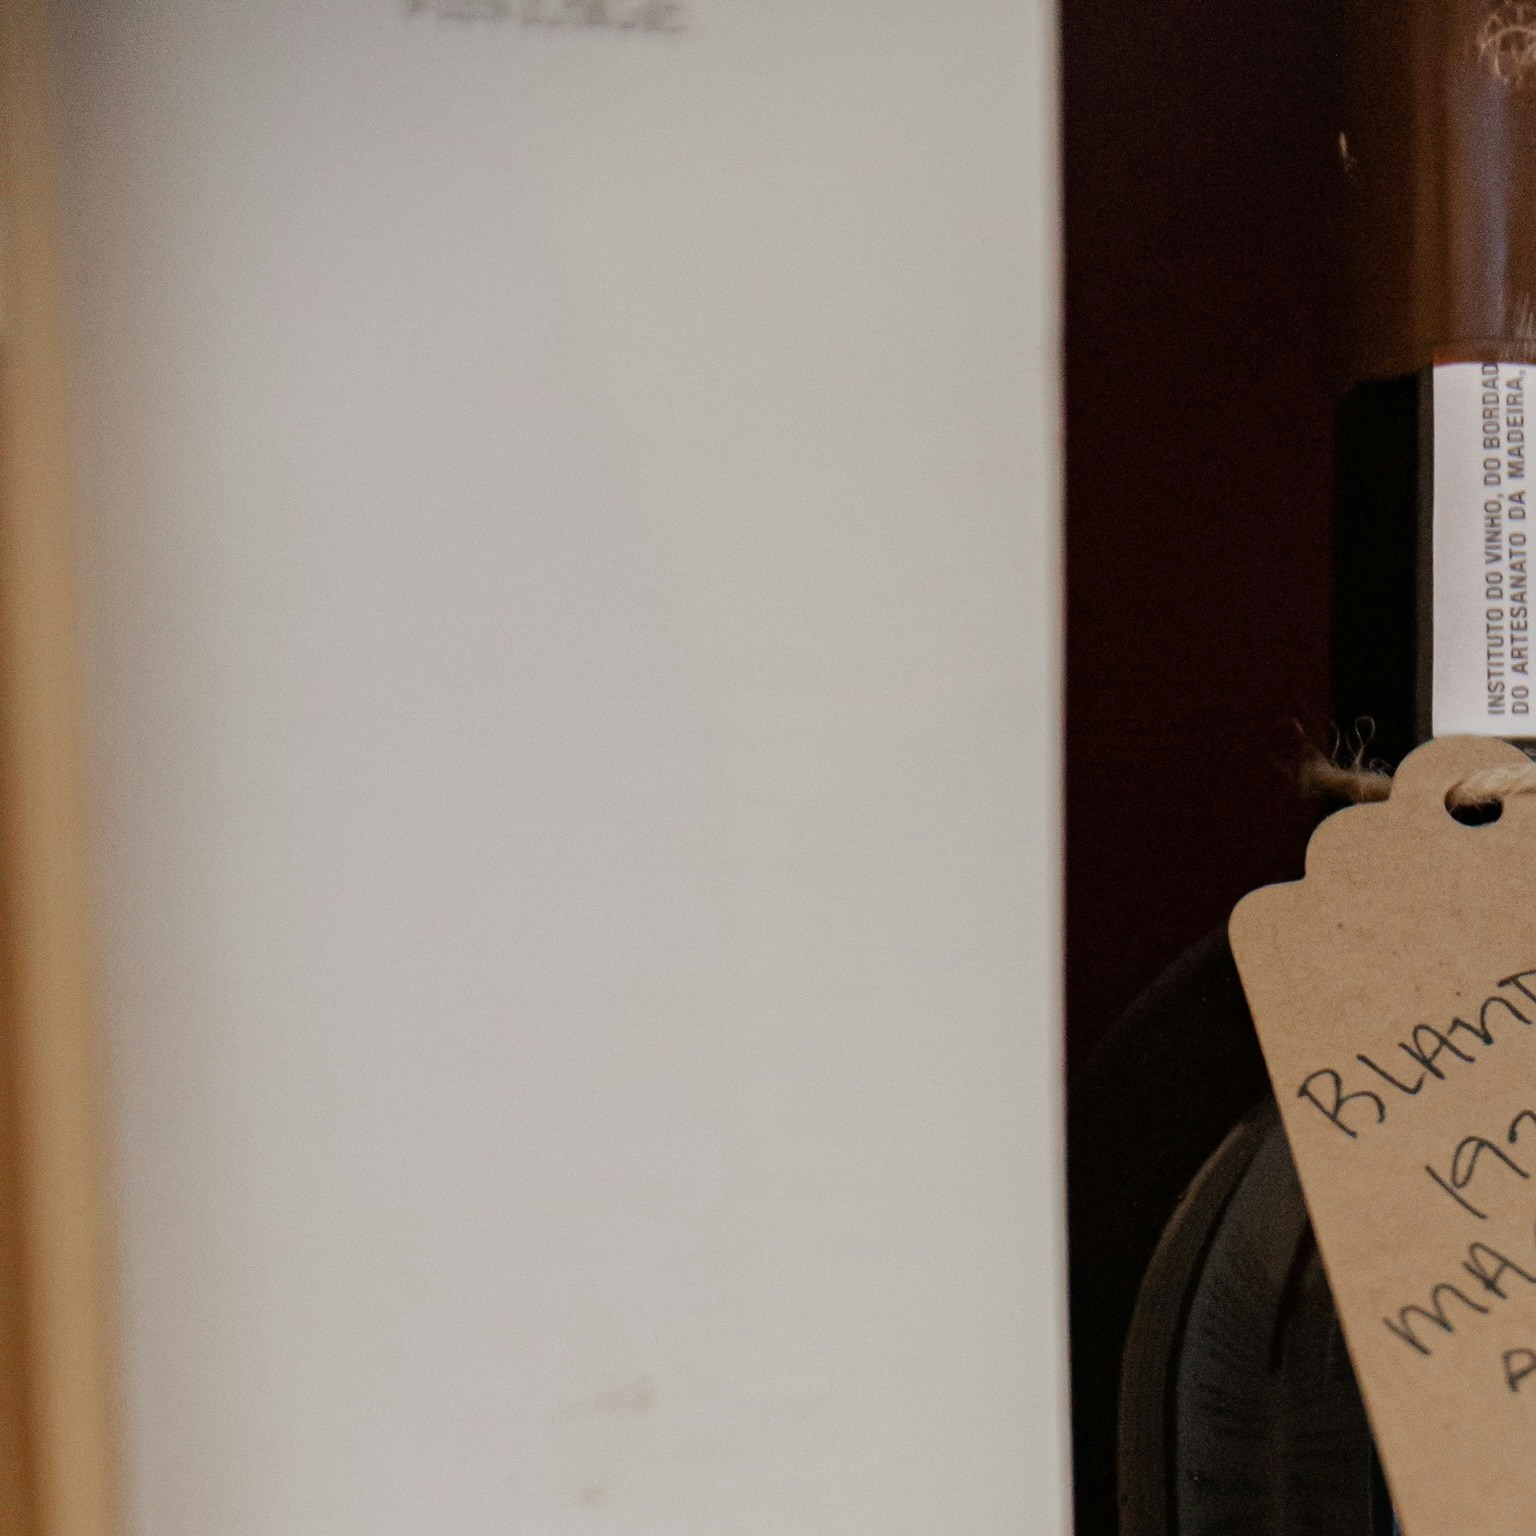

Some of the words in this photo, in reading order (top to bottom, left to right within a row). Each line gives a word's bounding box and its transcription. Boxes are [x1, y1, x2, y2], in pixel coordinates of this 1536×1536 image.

[1482, 362, 1501, 454] BORDAD
[1483, 457, 1502, 487] DO
[1484, 491, 1504, 567] VINHO,
[1508, 490, 1527, 522] DA
[1486, 570, 1504, 600] DO
[1508, 533, 1530, 675] ARTESANATO
[1487, 605, 1506, 716] INSTITUTO
[1511, 680, 1530, 715] DO
